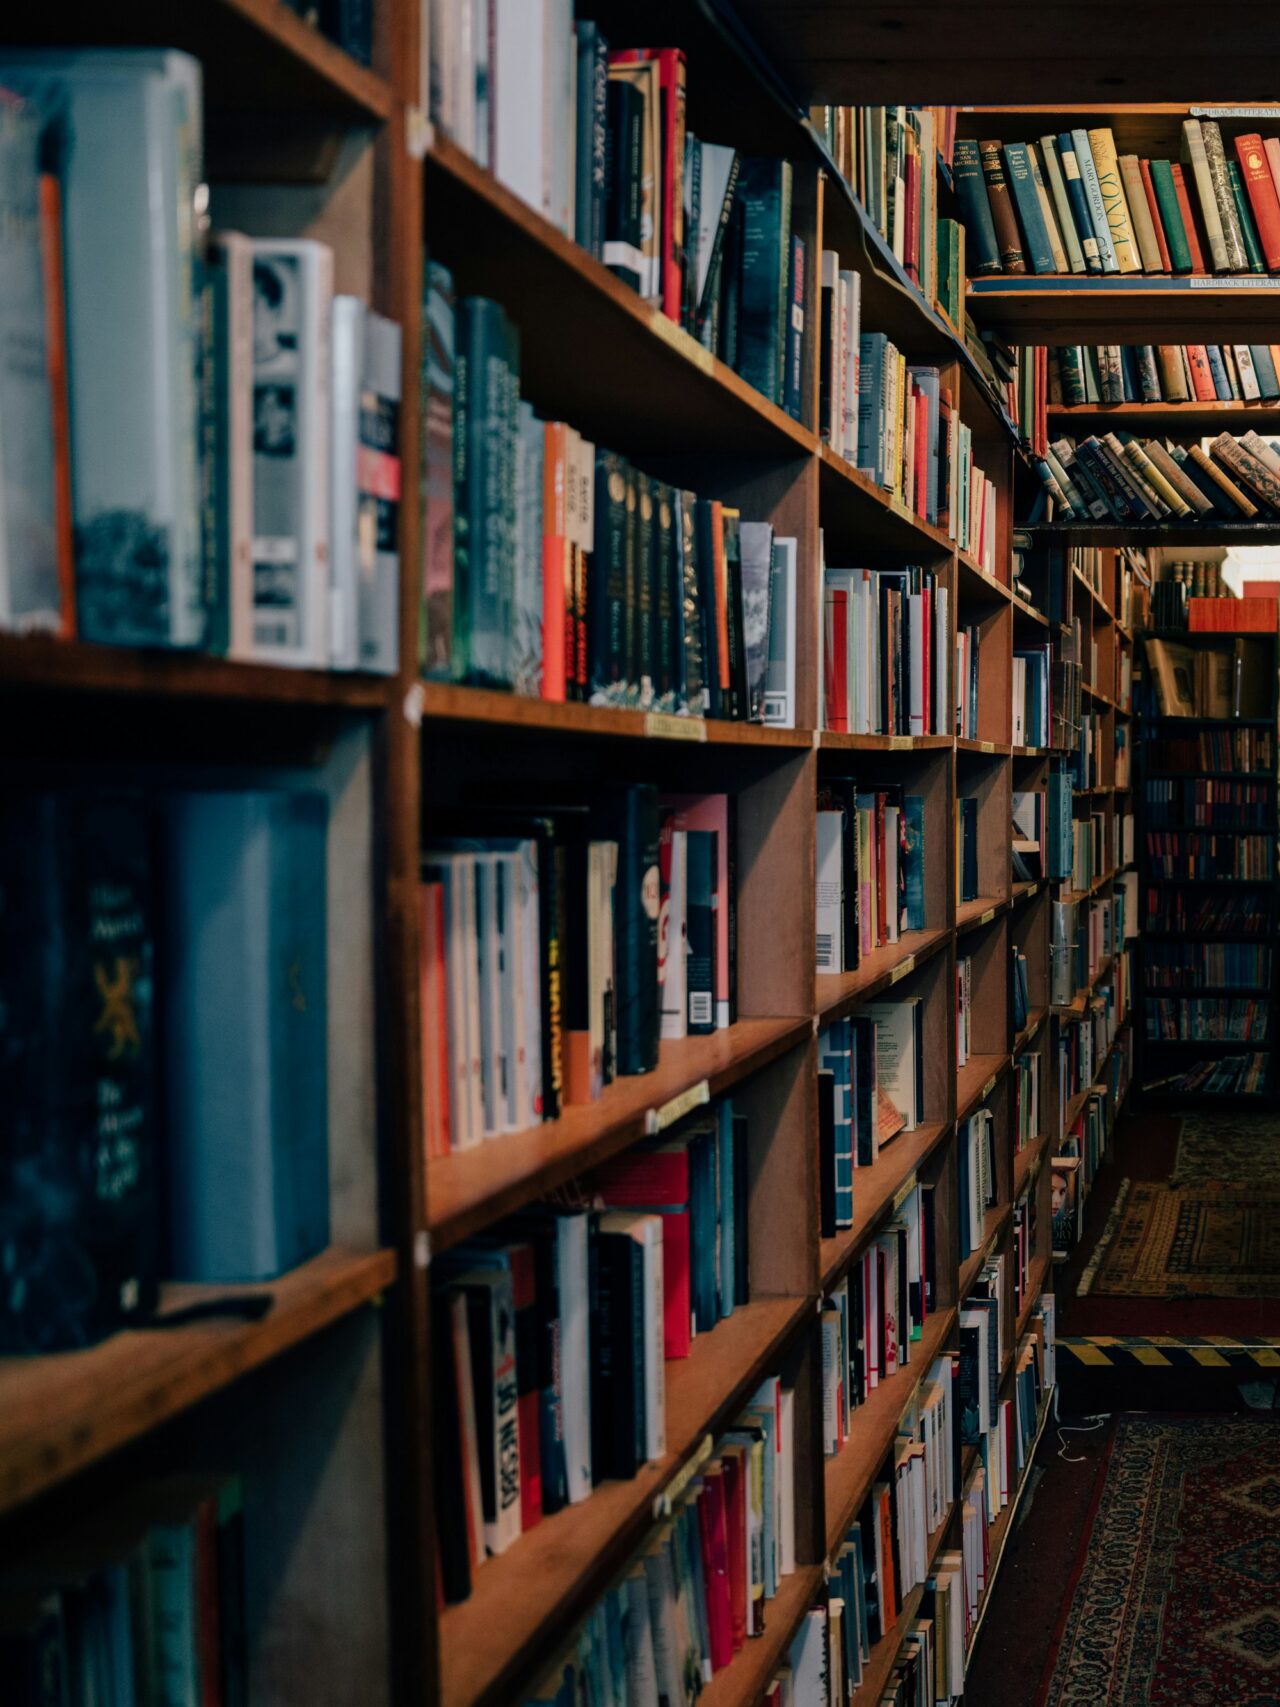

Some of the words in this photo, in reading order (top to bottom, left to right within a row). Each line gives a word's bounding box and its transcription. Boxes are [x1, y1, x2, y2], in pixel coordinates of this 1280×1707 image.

[1082, 158, 1095, 182] MARY
[1088, 183, 1105, 221] GORDON
[1097, 171, 1129, 246] SONYA
